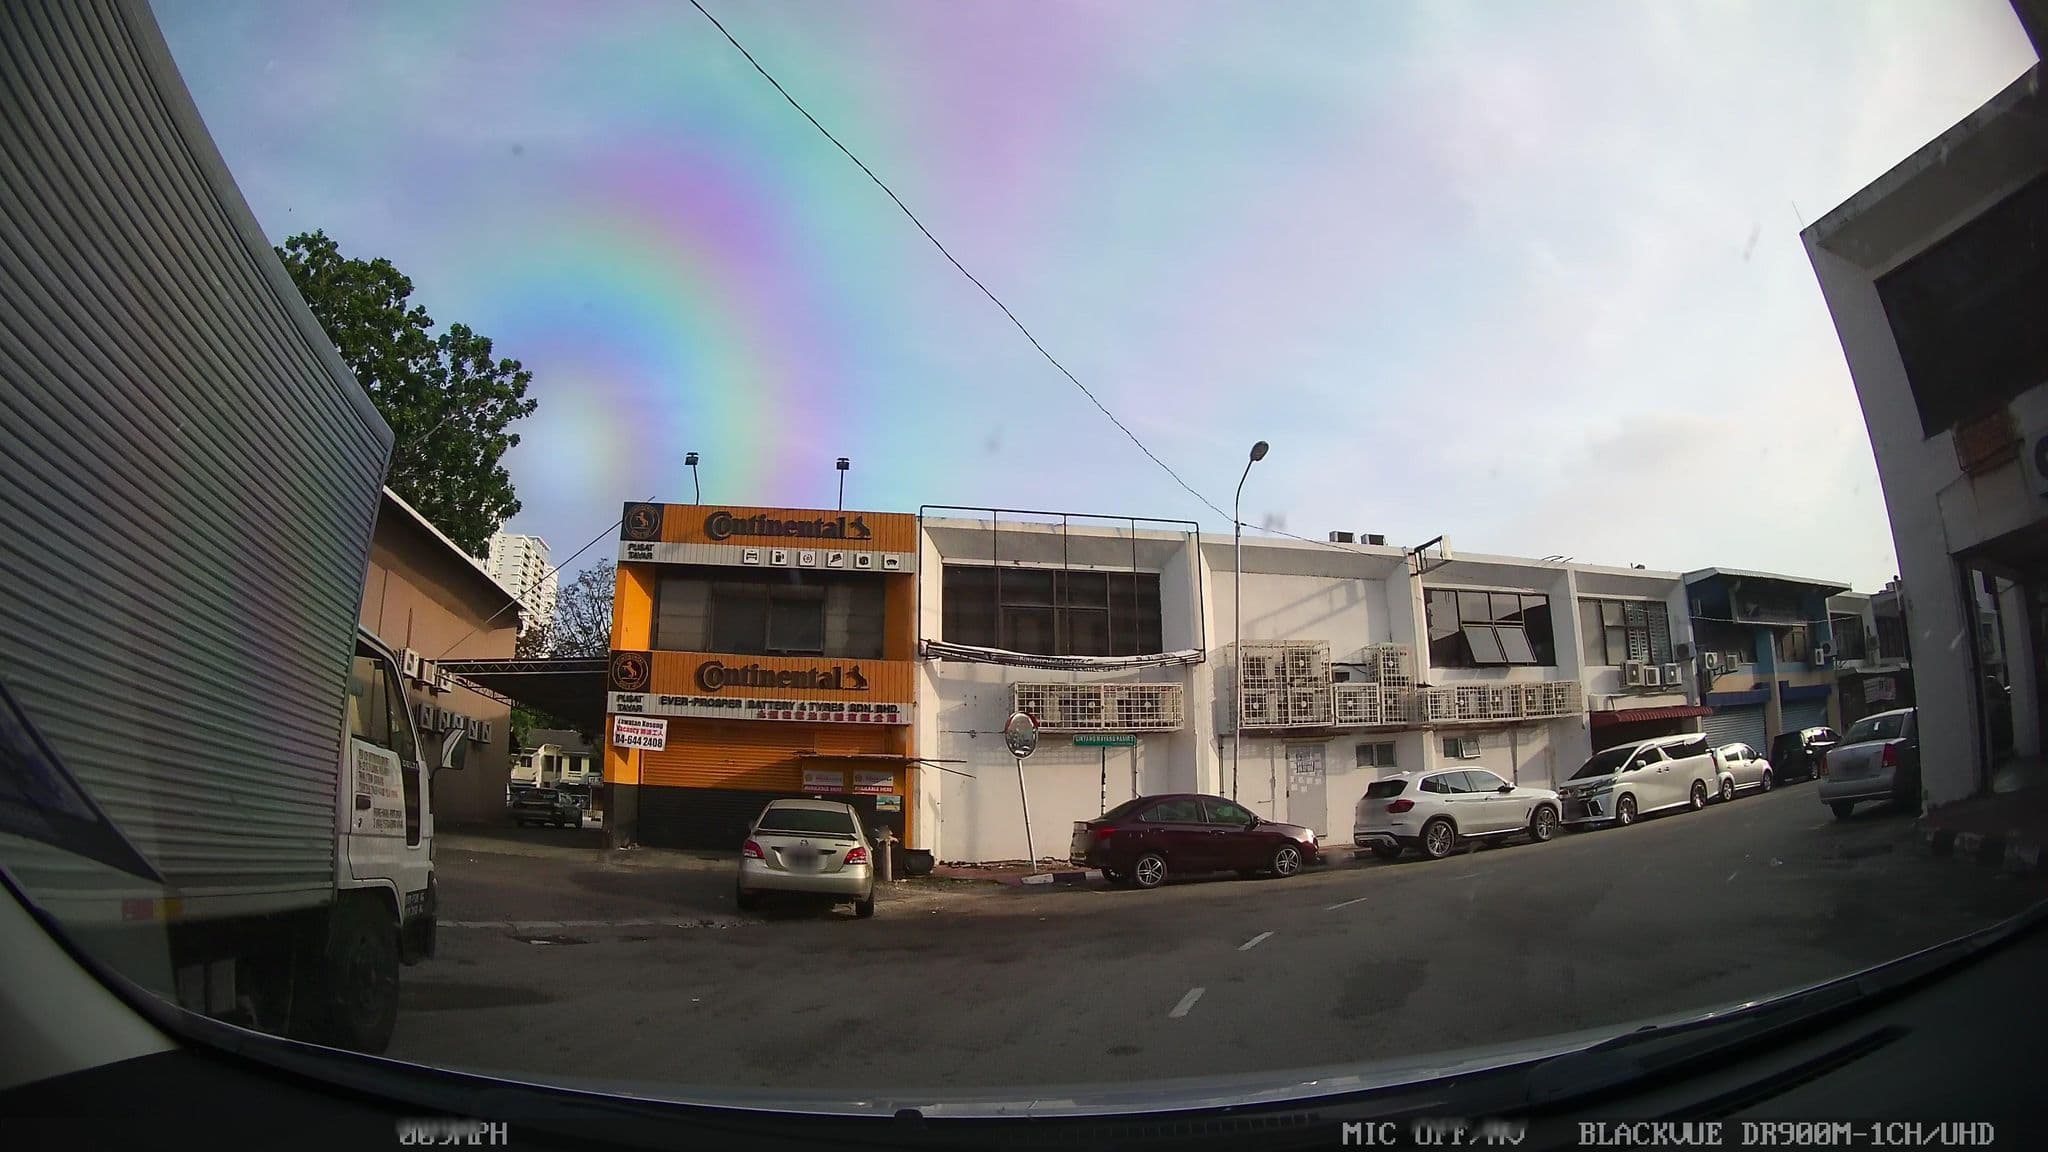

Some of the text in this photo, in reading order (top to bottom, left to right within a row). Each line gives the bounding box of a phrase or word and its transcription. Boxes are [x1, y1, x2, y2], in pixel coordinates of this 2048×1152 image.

[703, 511, 847, 540] Continental
[628, 543, 654, 551] PUSAT
[628, 551, 653, 560] TAYAR
[695, 660, 843, 692] Continental
[616, 694, 644, 703] PUSAT
[616, 703, 643, 713] TAYAR
[660, 695, 900, 714] EVER-PROSPER BATTERY & TYRES SDN. BHD.
[616, 724, 640, 735] Vacancy
[642, 720, 664, 730] Kosong
[615, 734, 663, 748] 04-644 2408
